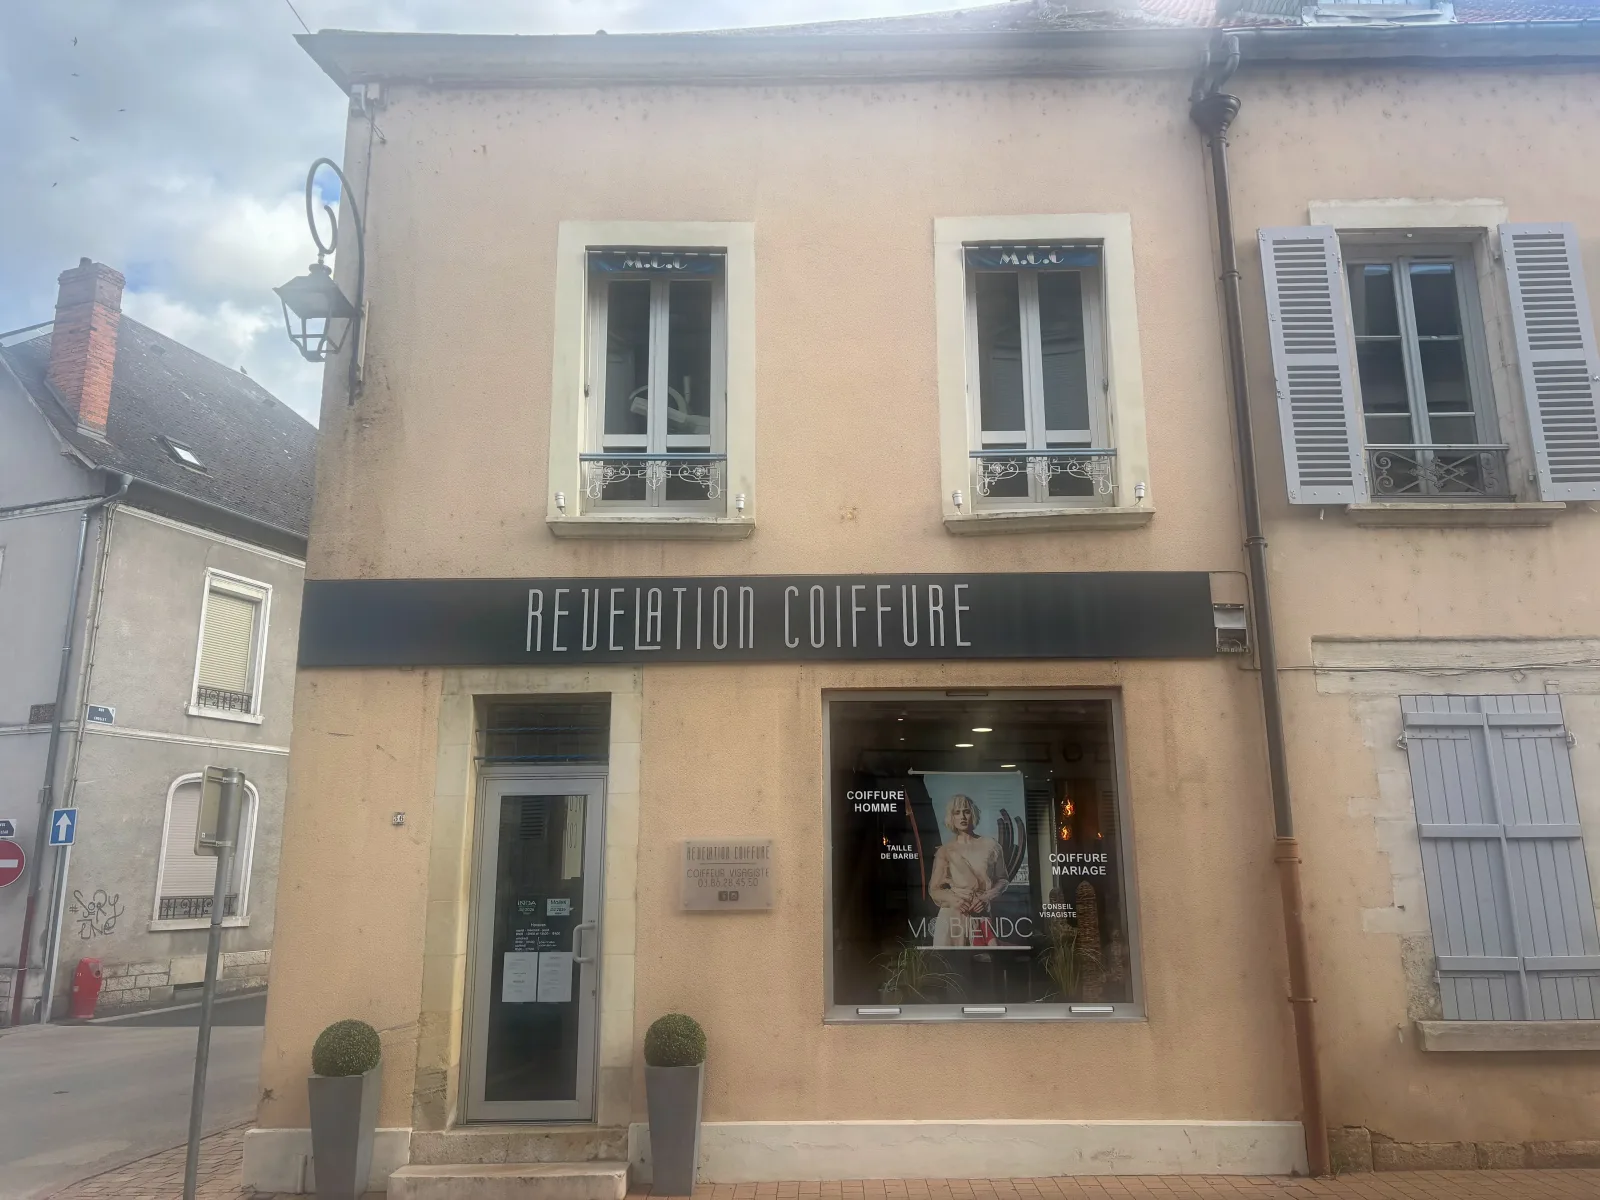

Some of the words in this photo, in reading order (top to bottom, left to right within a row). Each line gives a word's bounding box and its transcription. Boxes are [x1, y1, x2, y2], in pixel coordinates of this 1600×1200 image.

[526, 585, 754, 651] REVELATION
[784, 583, 972, 648] COIFFURE
[846, 790, 905, 800] COIFFURE
[854, 803, 898, 813] HOMME
[734, 845, 770, 860] COIFFURE
[886, 844, 913, 852] TAILLE
[880, 852, 891, 860] DE
[892, 852, 919, 860] BARBE
[1048, 853, 1108, 863] COIFFURE
[686, 869, 724, 878] COIFFEUR
[729, 867, 770, 878] VISAGISTE
[1052, 865, 1107, 876] MARIAGE
